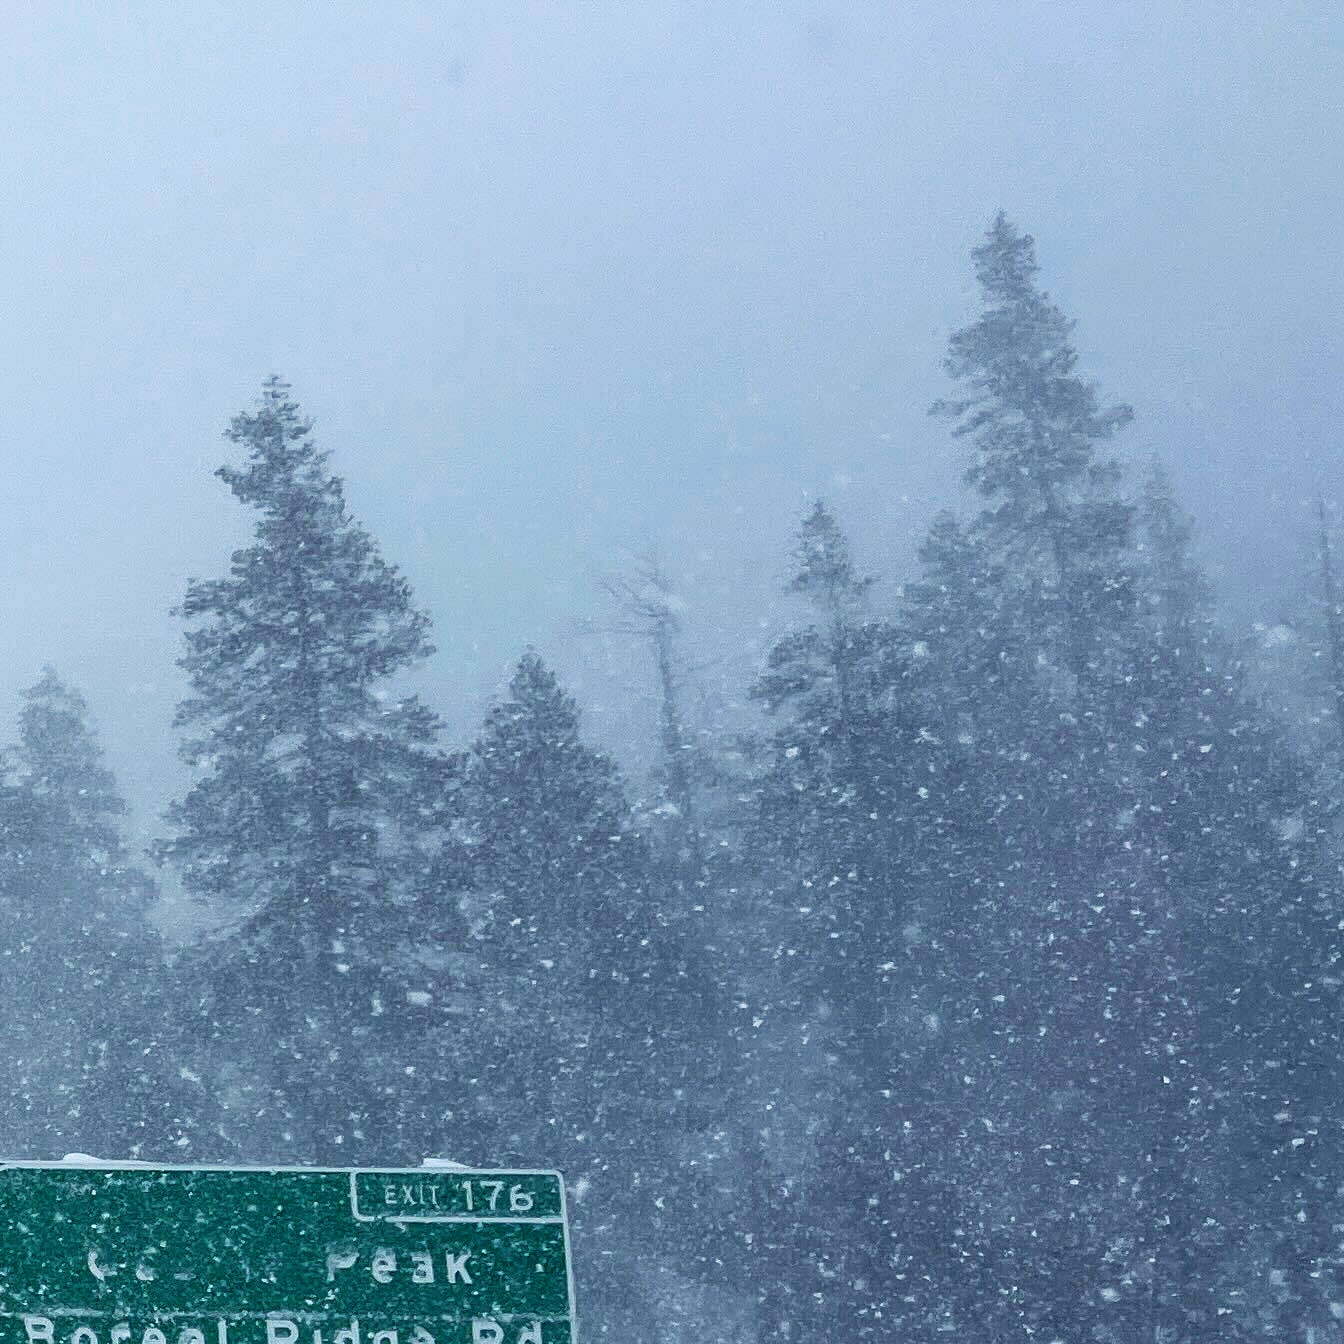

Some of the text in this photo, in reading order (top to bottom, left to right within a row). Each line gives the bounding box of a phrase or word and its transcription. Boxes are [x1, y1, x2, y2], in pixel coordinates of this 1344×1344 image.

[385, 1180, 534, 1211] EXIT 176
[326, 1242, 473, 1284] Peak
